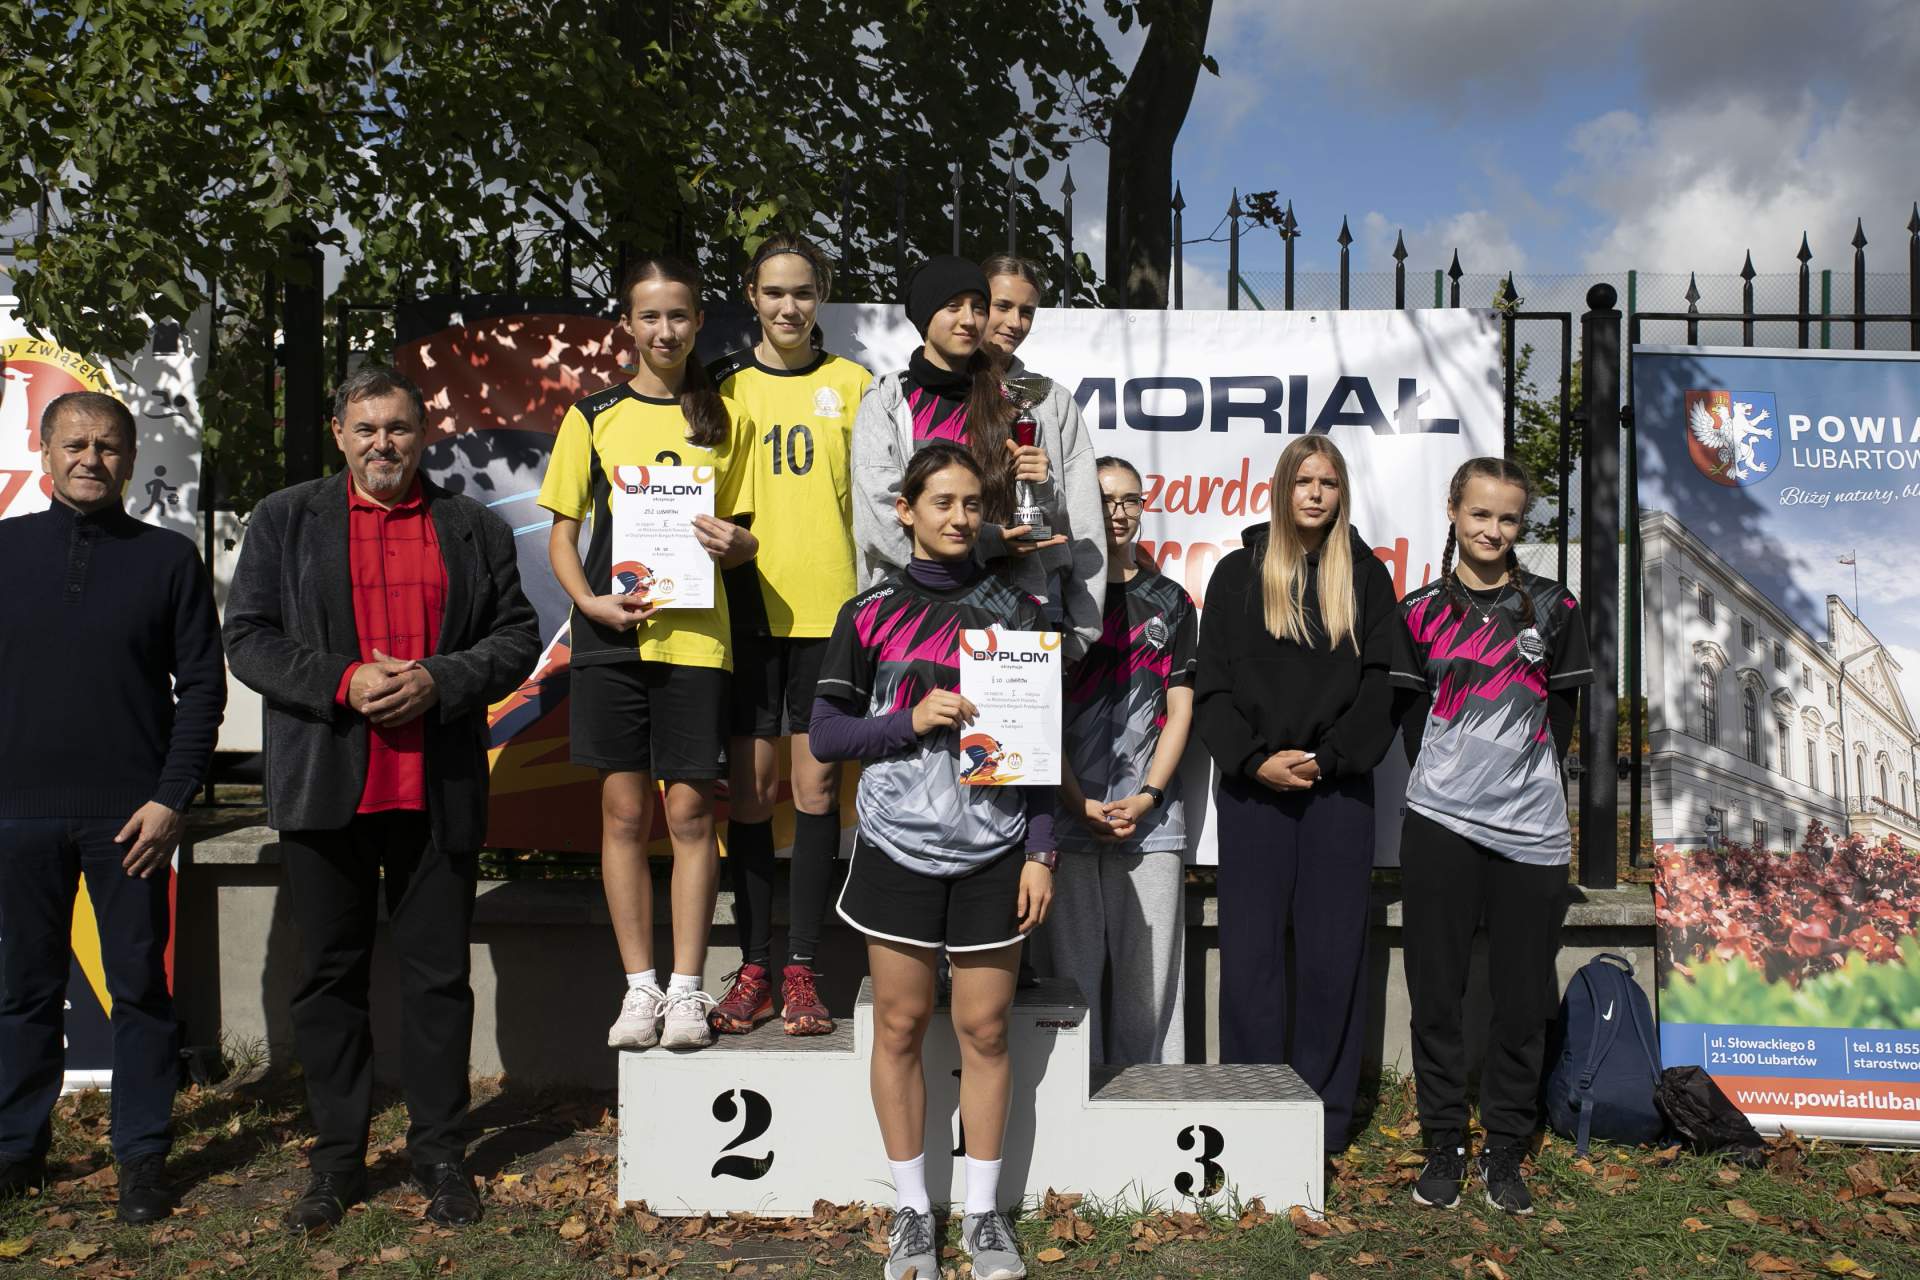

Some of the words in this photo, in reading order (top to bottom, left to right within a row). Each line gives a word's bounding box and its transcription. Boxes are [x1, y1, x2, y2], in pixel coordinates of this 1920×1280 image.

[763, 424, 815, 476] 10
[626, 485, 702, 496] DYPLOM
[1779, 486, 1832, 508] Bliżej
[1833, 488, 1899, 505] natury,
[973, 651, 1049, 663] DYPLOM
[1711, 1037, 1726, 1048] ul.
[1727, 1037, 1805, 1053] Słowackiego
[1807, 1039, 1816, 1051] 8
[1853, 1041, 1873, 1053] tel.
[1875, 1042, 1892, 1054] 81
[1711, 1052, 1756, 1064] 21-100
[1757, 1054, 1817, 1067] Lubartów
[1854, 1058, 1920, 1070] starostwo
[710, 1088, 775, 1181] 2
[1173, 1124, 1226, 1198] 3
